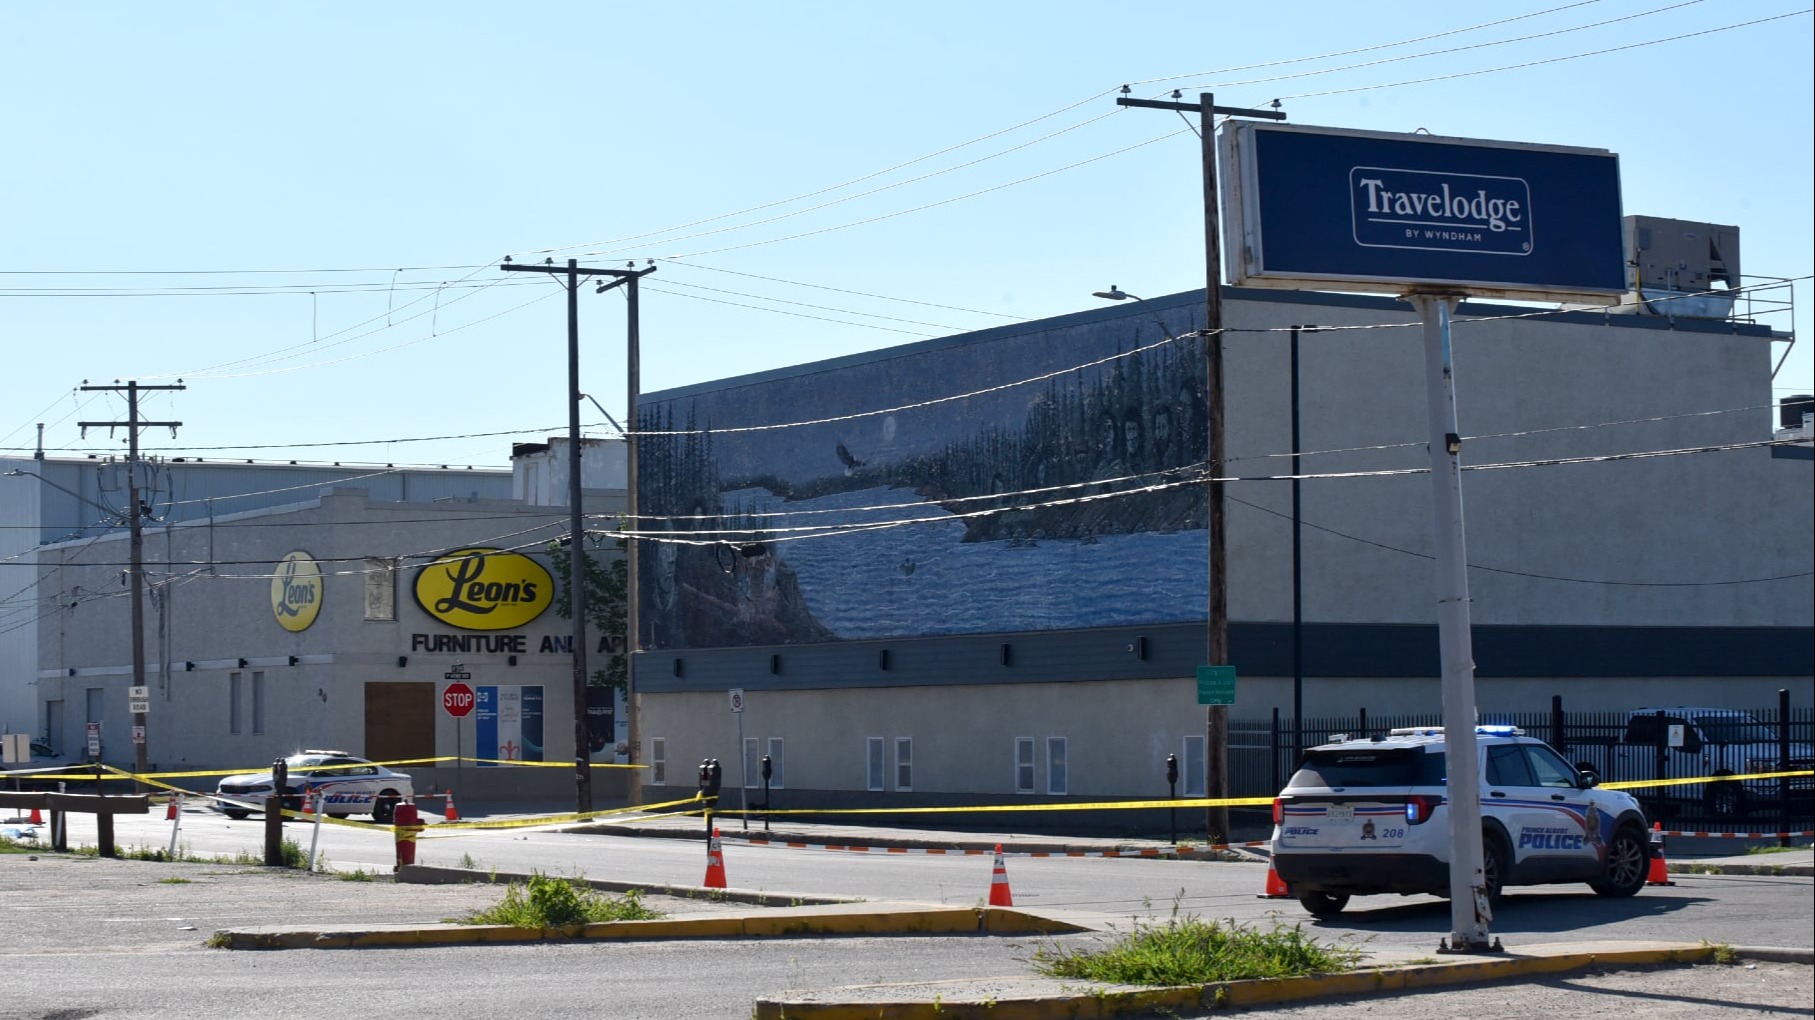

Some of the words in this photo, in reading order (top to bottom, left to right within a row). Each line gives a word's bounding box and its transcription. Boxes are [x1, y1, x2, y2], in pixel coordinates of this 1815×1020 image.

[1360, 178, 1521, 232] Travelodge
[1405, 229, 1419, 238] BY
[1425, 230, 1482, 242] WYNDHAM
[277, 555, 315, 617] Leon's
[435, 552, 538, 614] Leon's
[412, 633, 526, 653] FURNITURE
[133, 703, 147, 711] ROAD
[445, 693, 473, 707] STOP
[1284, 827, 1320, 835] POLICE
[1382, 828, 1404, 838] 208
[1519, 832, 1584, 850] POLICE
